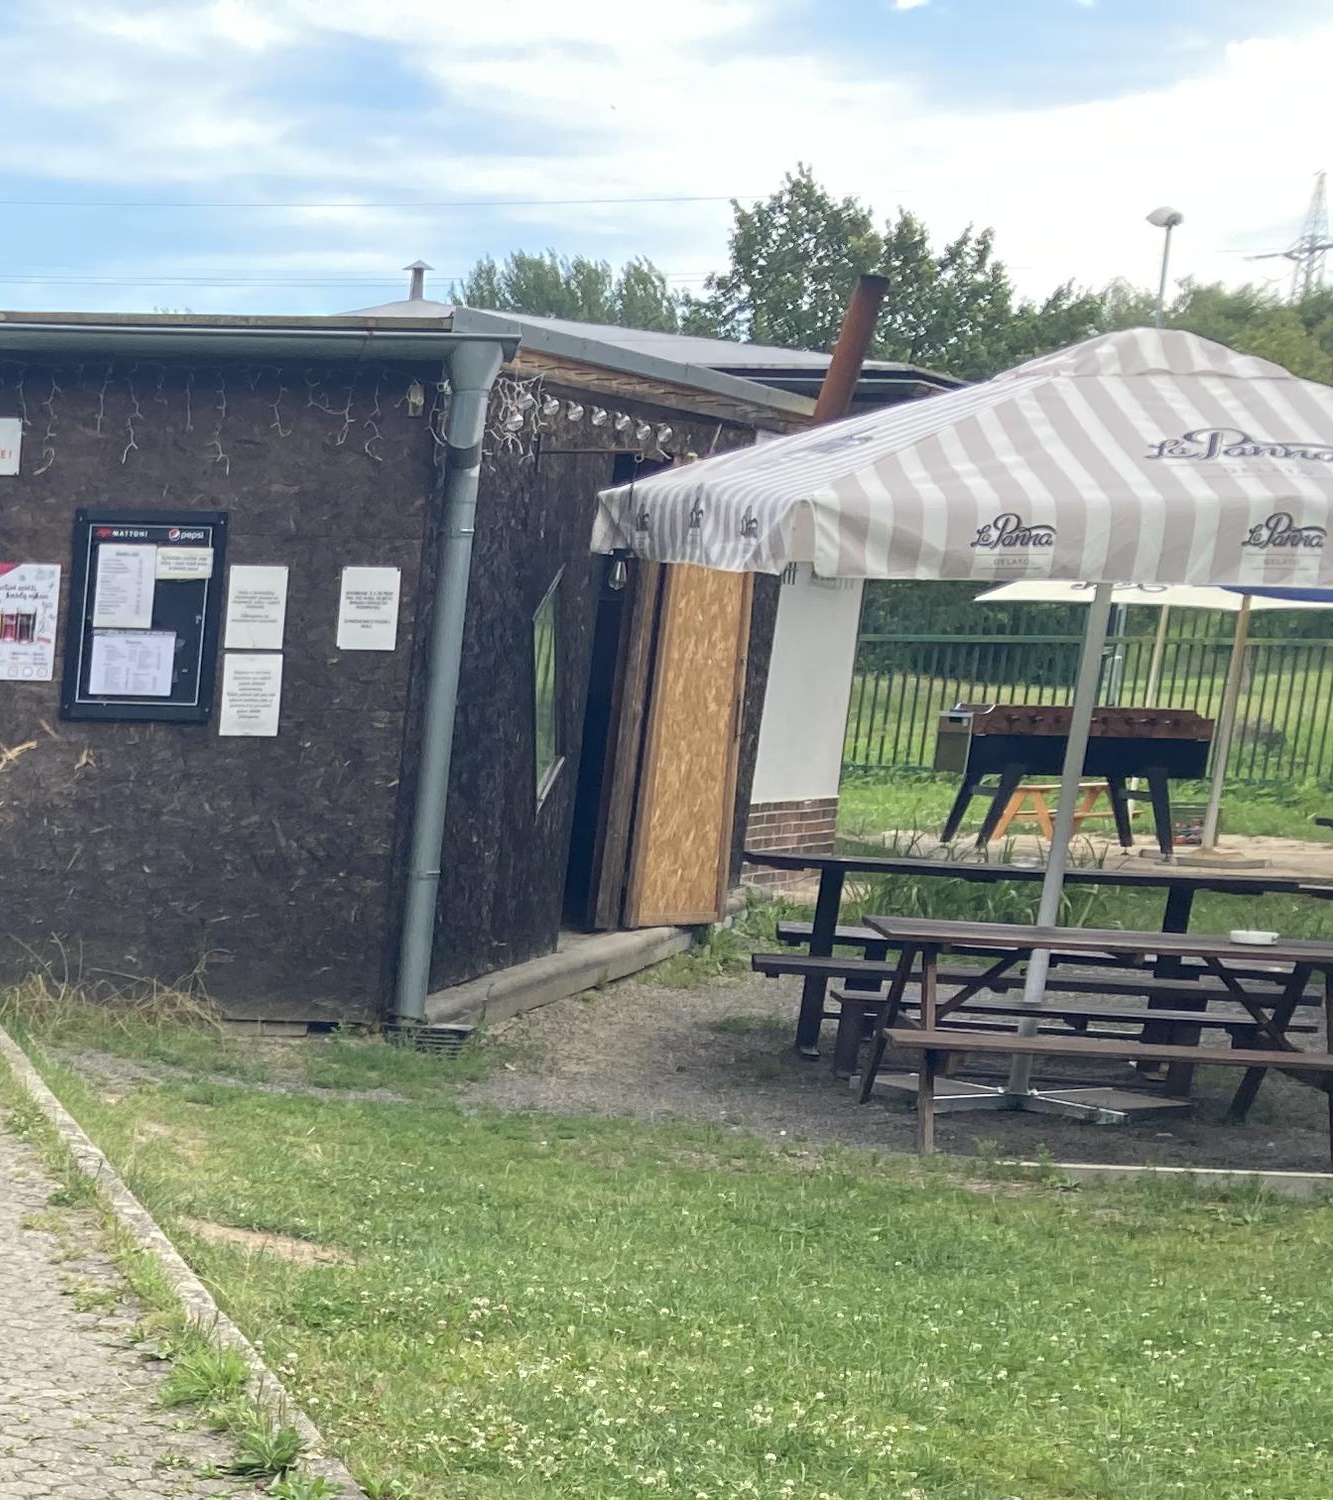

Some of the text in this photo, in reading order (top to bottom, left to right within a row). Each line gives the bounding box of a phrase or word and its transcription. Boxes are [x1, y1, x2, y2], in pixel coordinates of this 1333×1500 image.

[180, 531, 204, 541] pepsi
[970, 512, 1057, 549] La Panna
[1241, 512, 1327, 549] La Panna
[994, 558, 1031, 567] GELATO
